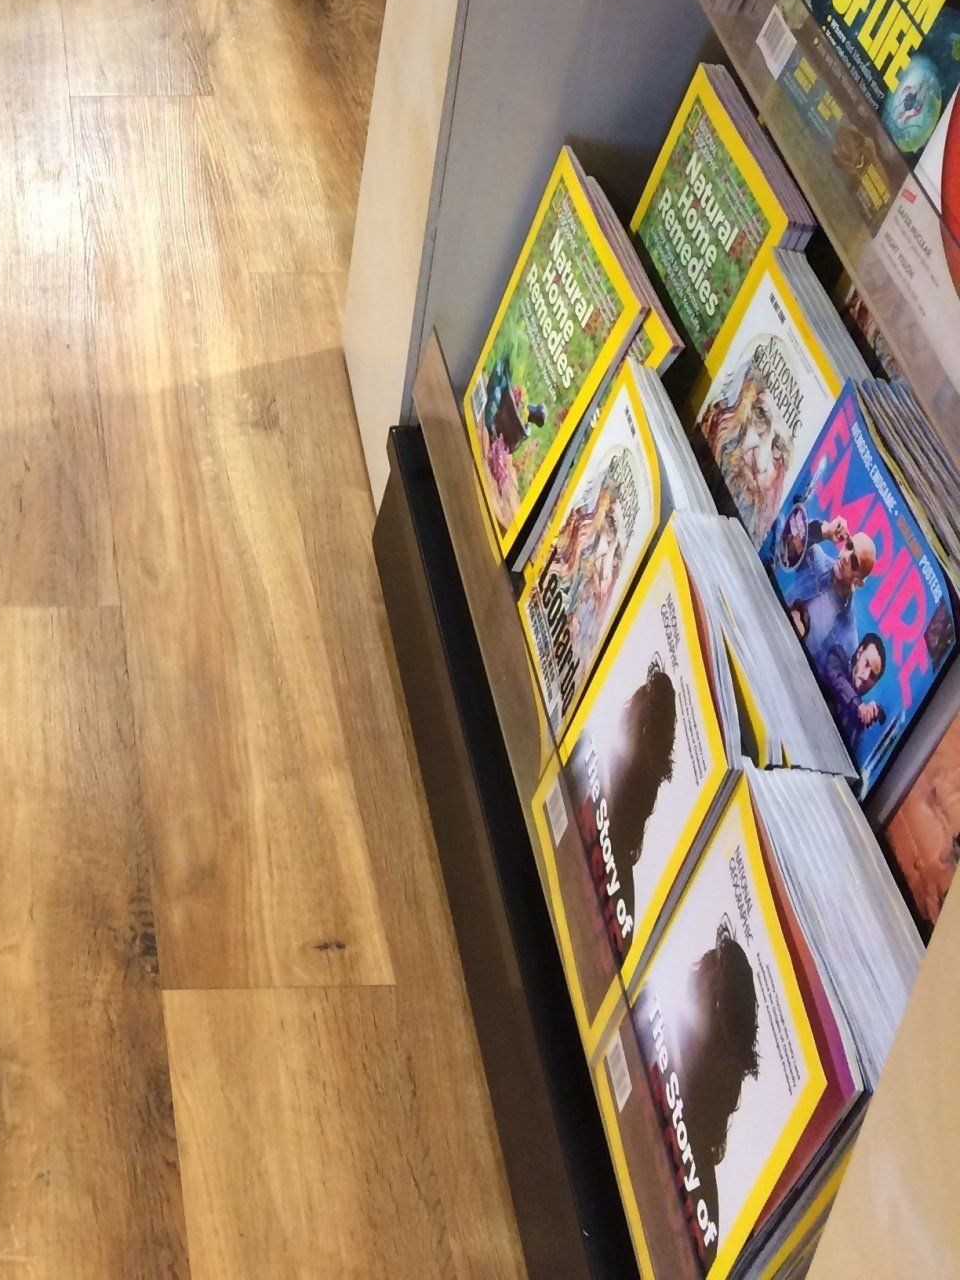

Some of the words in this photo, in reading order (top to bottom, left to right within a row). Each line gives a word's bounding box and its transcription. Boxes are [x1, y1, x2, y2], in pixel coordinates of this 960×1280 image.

[658, 187, 719, 317] Remedies
[677, 184, 717, 265] Home
[685, 152, 740, 252] Natural
[526, 263, 574, 389] Remedies
[542, 260, 574, 345] Home
[550, 228, 594, 329] Natural
[752, 344, 803, 438] GEOGRAPHIC
[765, 336, 804, 415] NATIONAL
[810, 408, 929, 709] EMPIRE
[850, 421, 873, 471] AVENGERS:
[869, 465, 897, 515] ENDGAME
[919, 554, 944, 605] POSTERS
[539, 546, 580, 719] Leonardo
[584, 734, 602, 803] The
[596, 798, 622, 897] Story
[616, 898, 634, 939] of
[734, 845, 753, 918] NATIONAL
[729, 856, 754, 948] GEOGRAPHIC
[649, 993, 669, 1074] The
[665, 1071, 702, 1193] Story
[696, 1198, 719, 1248] of
